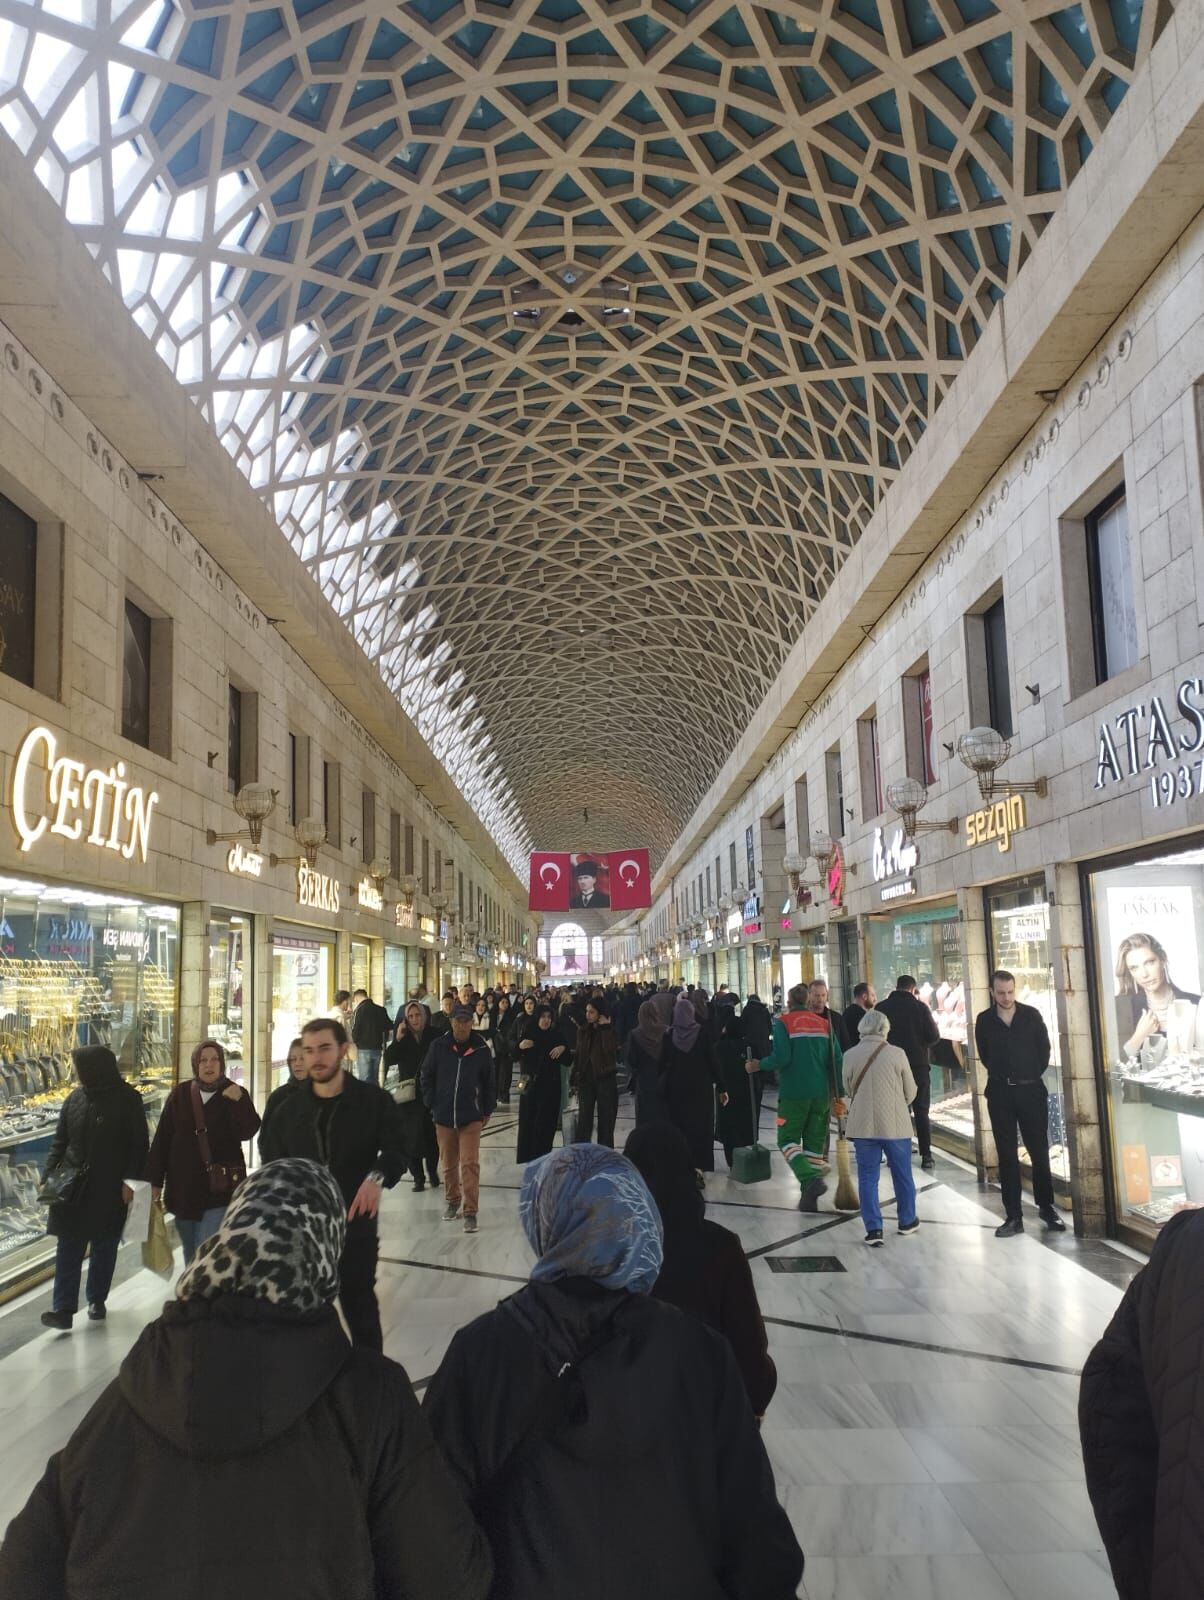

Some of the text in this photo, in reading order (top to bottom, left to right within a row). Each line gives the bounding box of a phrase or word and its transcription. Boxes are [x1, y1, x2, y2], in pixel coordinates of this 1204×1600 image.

[13, 726, 159, 863] ÇETİN
[1150, 759, 1204, 808] 1937
[965, 794, 1026, 853] sezgin
[298, 860, 340, 914] BERKAS
[1016, 918, 1040, 927] ALTIN
